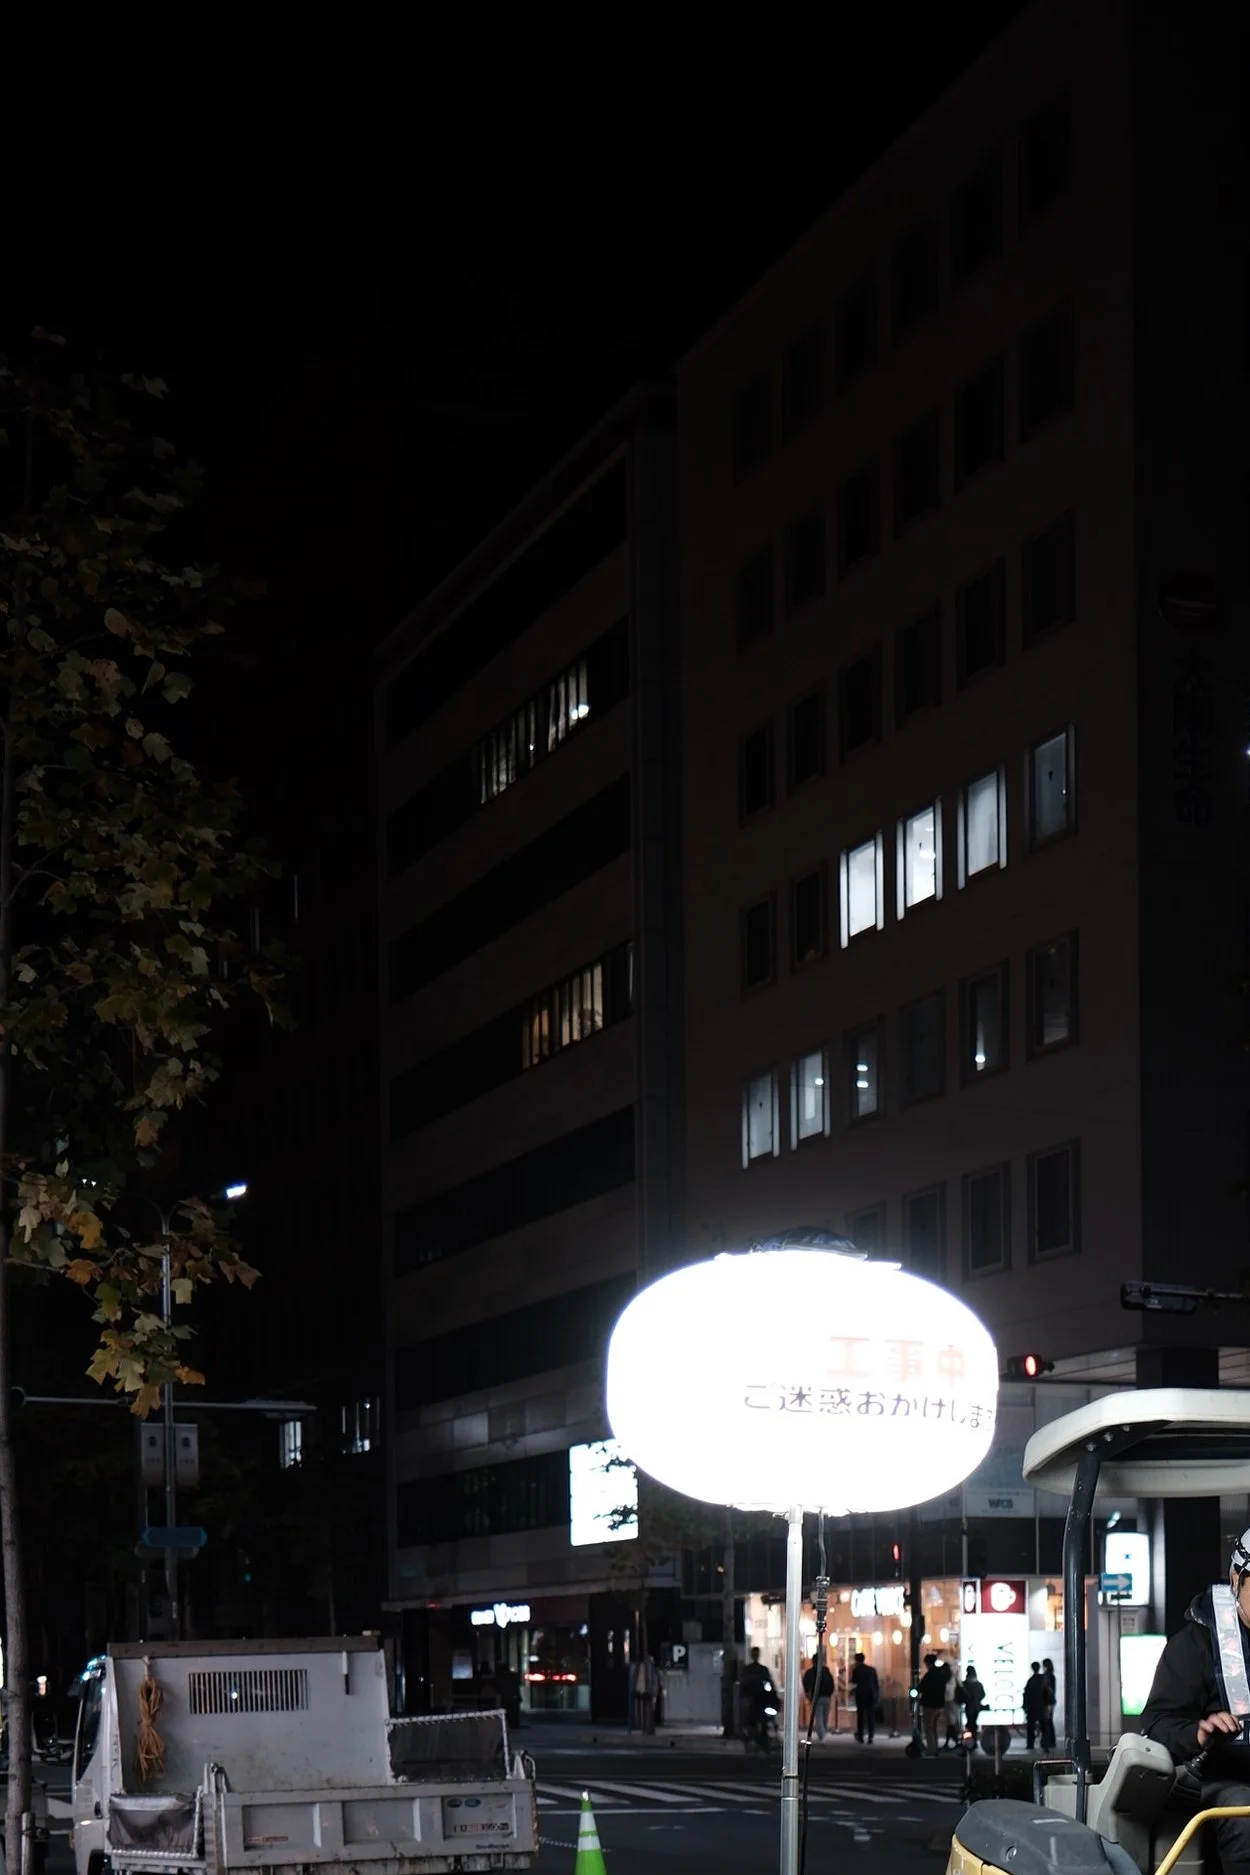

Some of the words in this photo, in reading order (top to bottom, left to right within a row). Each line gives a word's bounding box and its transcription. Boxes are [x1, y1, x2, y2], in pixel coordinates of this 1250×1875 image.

[826, 1335, 965, 1388] 工事中
[673, 1644, 687, 1663] P
